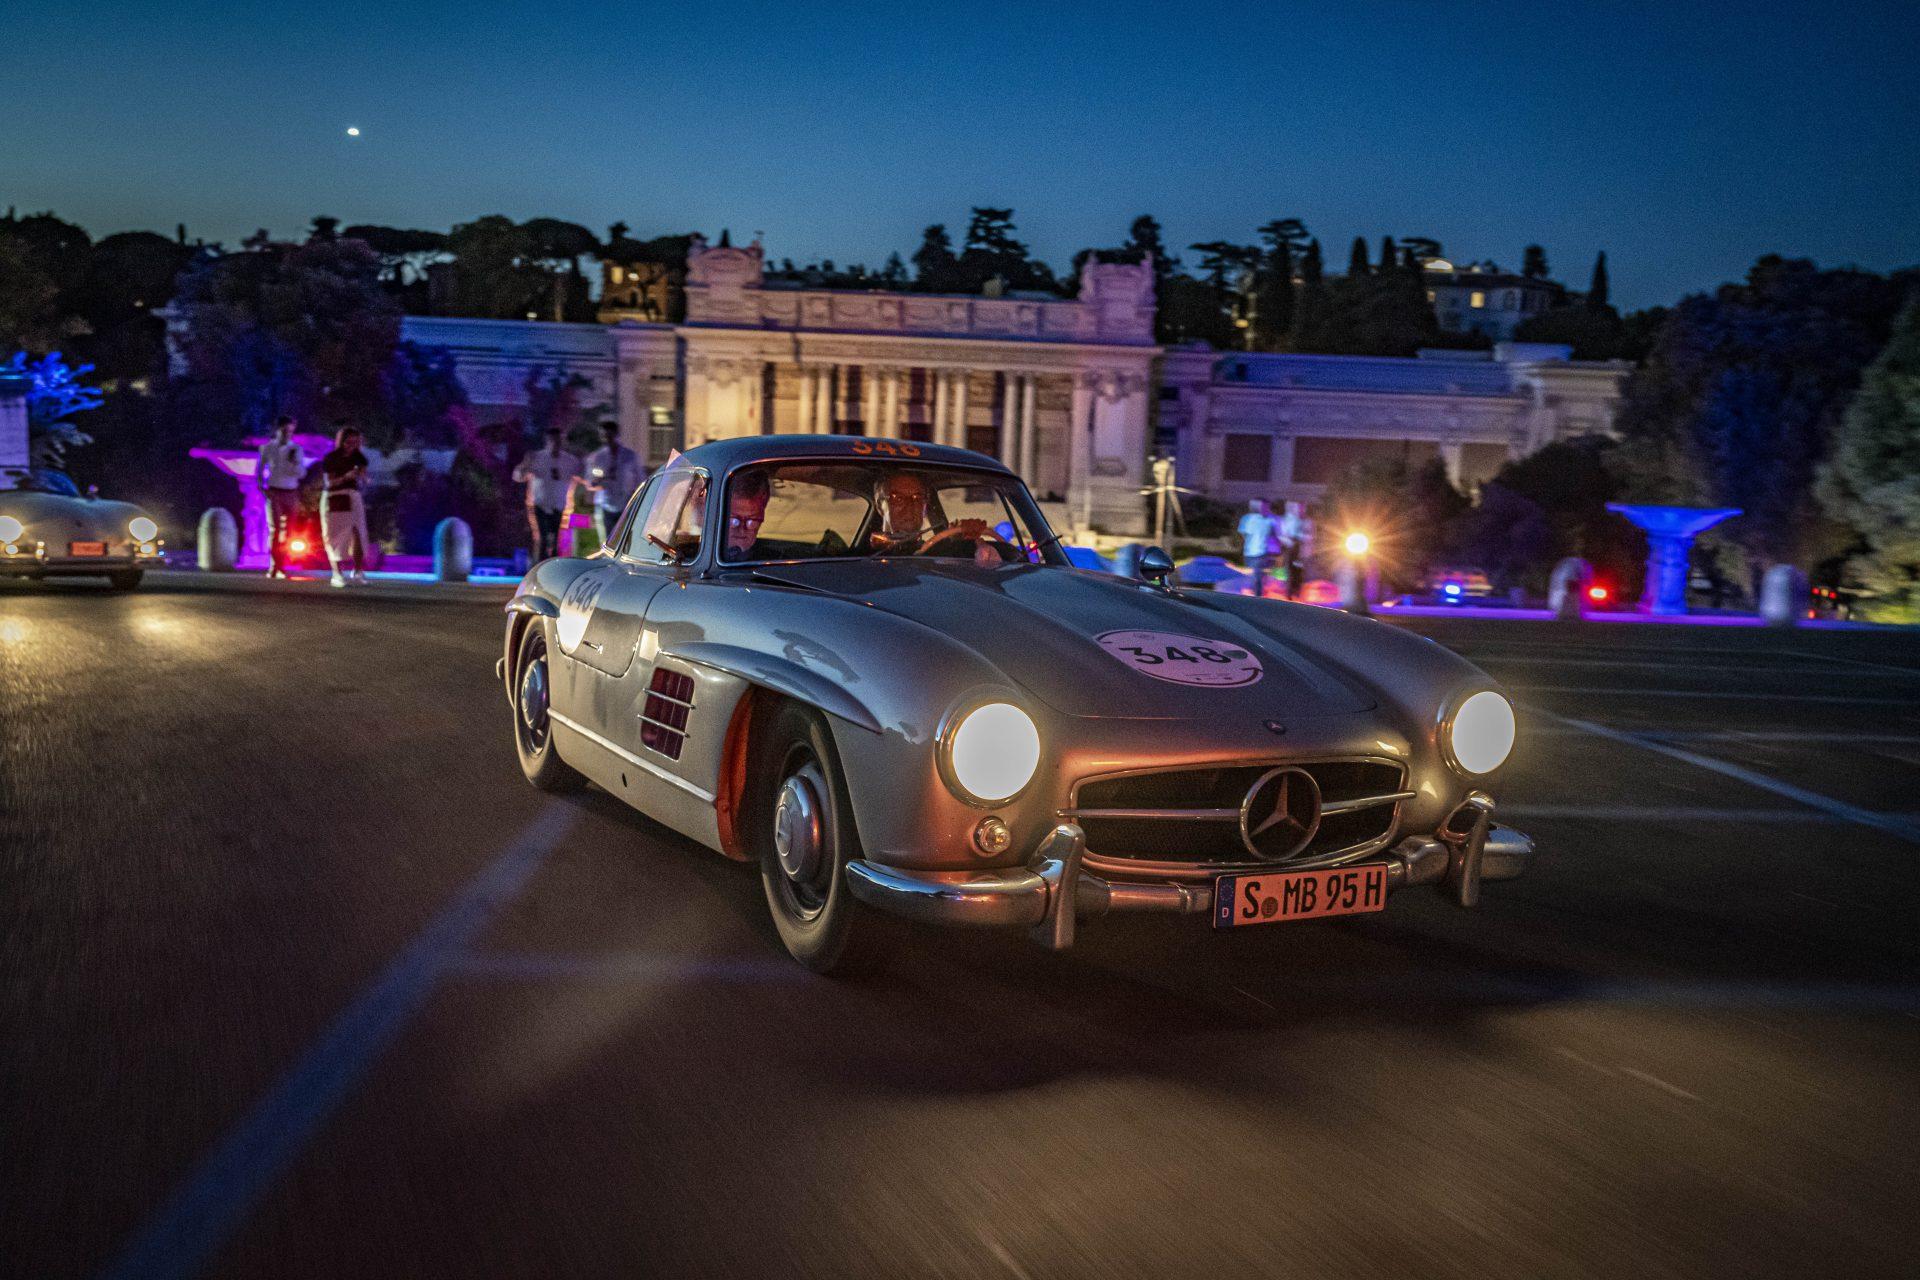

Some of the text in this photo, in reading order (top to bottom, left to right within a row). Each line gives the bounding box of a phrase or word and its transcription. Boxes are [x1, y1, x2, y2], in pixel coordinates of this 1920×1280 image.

[1118, 645, 1233, 665] 348
[1242, 881, 1261, 919] S
[1282, 877, 1318, 915] MB
